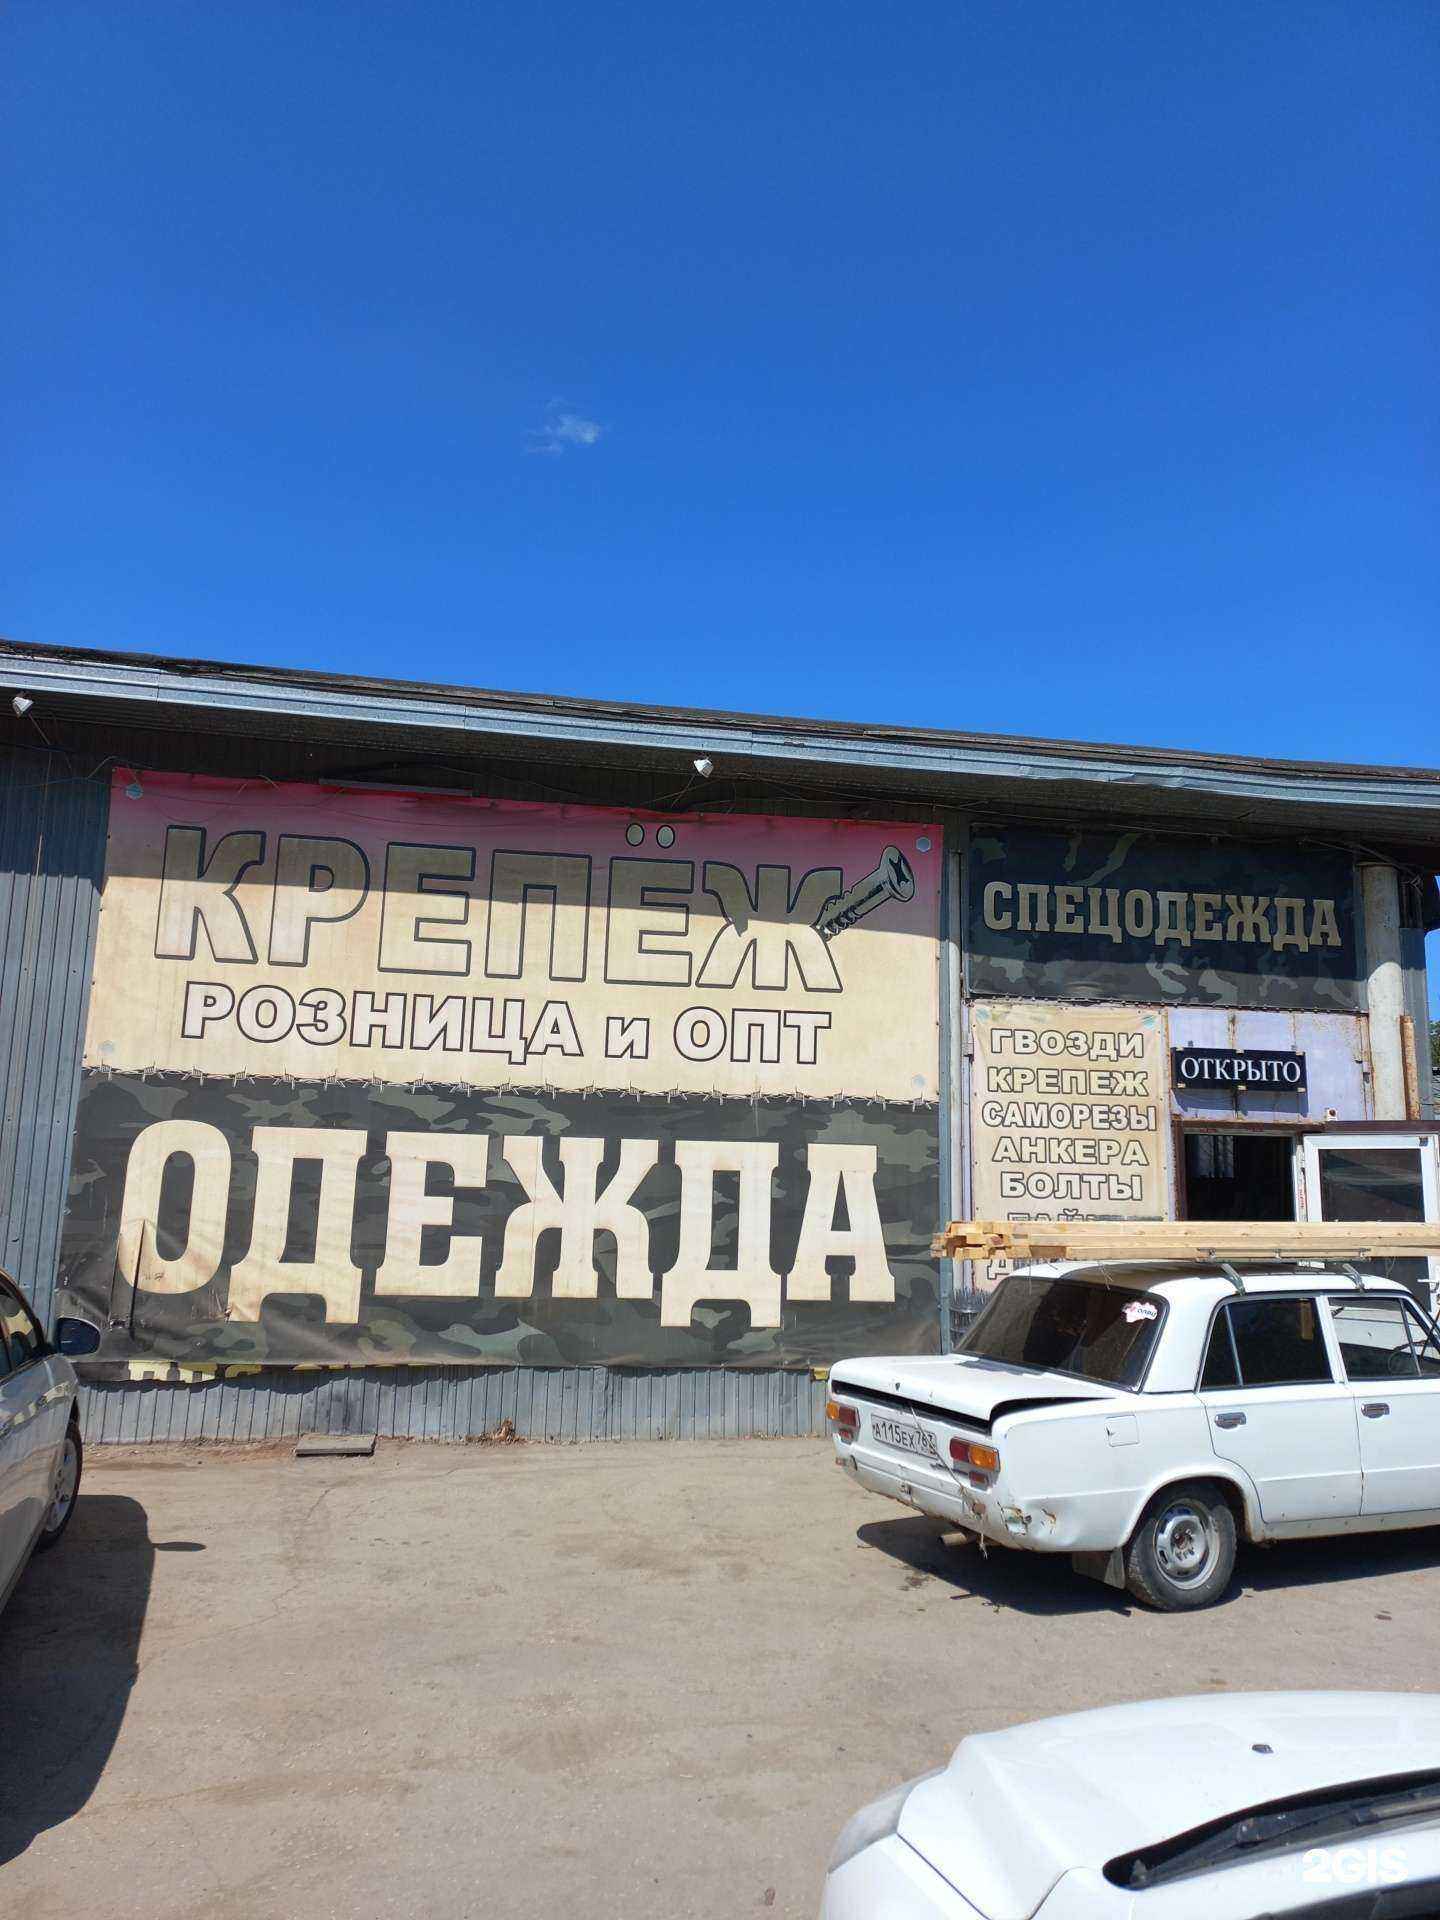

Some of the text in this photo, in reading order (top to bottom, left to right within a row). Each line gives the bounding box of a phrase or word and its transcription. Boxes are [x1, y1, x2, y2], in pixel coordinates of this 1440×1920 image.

[154, 822, 844, 993] КРЕПЁЖ
[983, 881, 1342, 953] СПЕЦОДЕЖДА
[181, 981, 832, 1065] РОЗНИЦА и ОПТ
[990, 1028, 1145, 1061] ГВОЗДИ
[987, 1066, 1148, 1097] КРЕПЕЖ
[1180, 1056, 1301, 1084] ОТКРЫТО
[981, 1100, 1157, 1131] САМОРЕЗЫ
[992, 1136, 1150, 1166] АНКЕРА
[1000, 1171, 1144, 1201] БОЛТЫ
[117, 1119, 896, 1327] ОДЕЖДА
